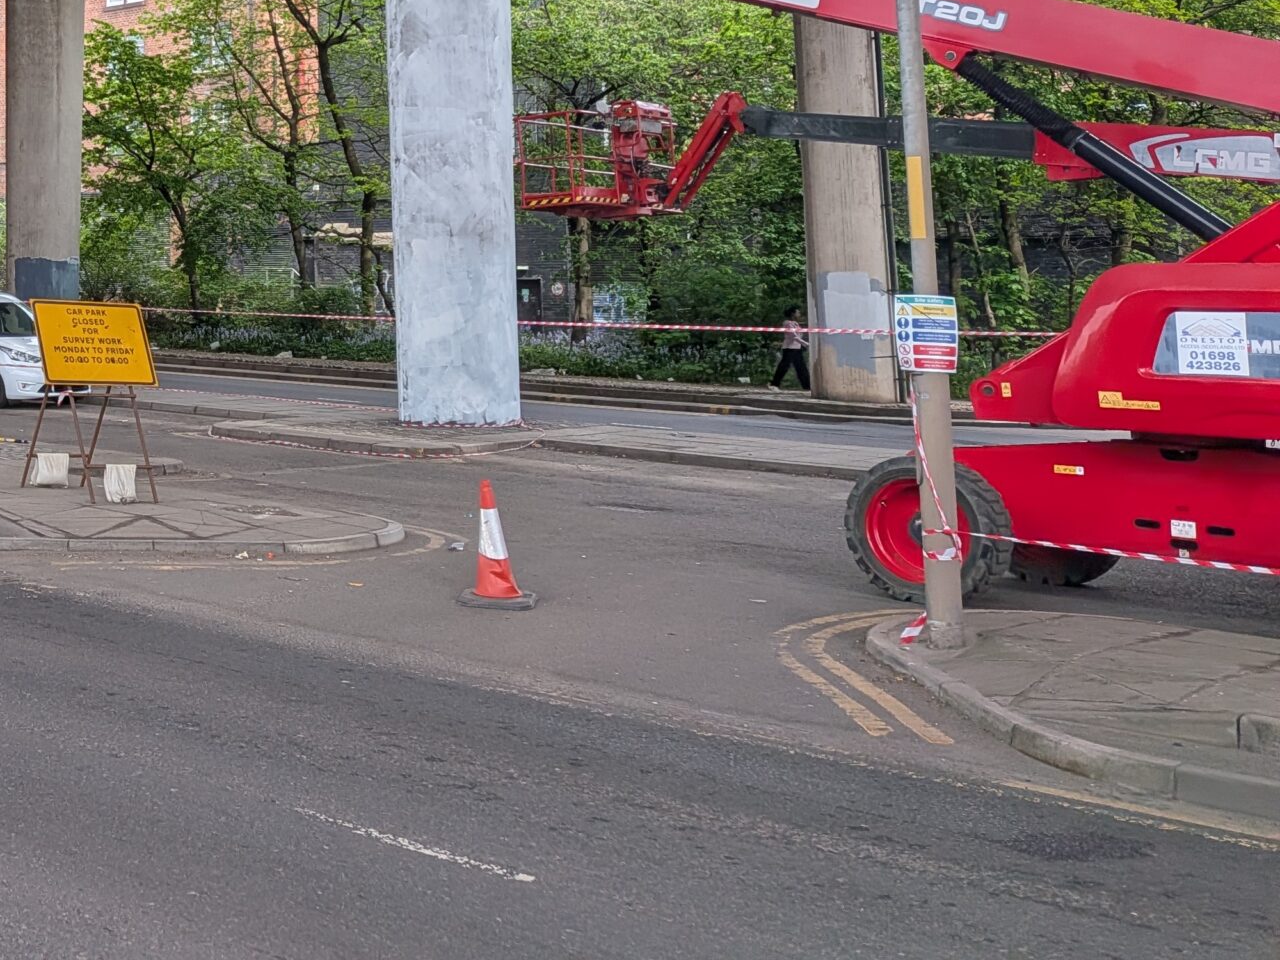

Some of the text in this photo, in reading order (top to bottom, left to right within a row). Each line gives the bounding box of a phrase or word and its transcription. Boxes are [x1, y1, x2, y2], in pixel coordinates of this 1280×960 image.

[66, 308, 82, 316] CAR
[72, 318, 105, 326] CLOSED
[63, 336, 122, 345] SURVEY WORK
[53, 346, 90, 354] MONDAY
[1190, 351, 1235, 361] 01698
[1186, 361, 1241, 371] 423826
